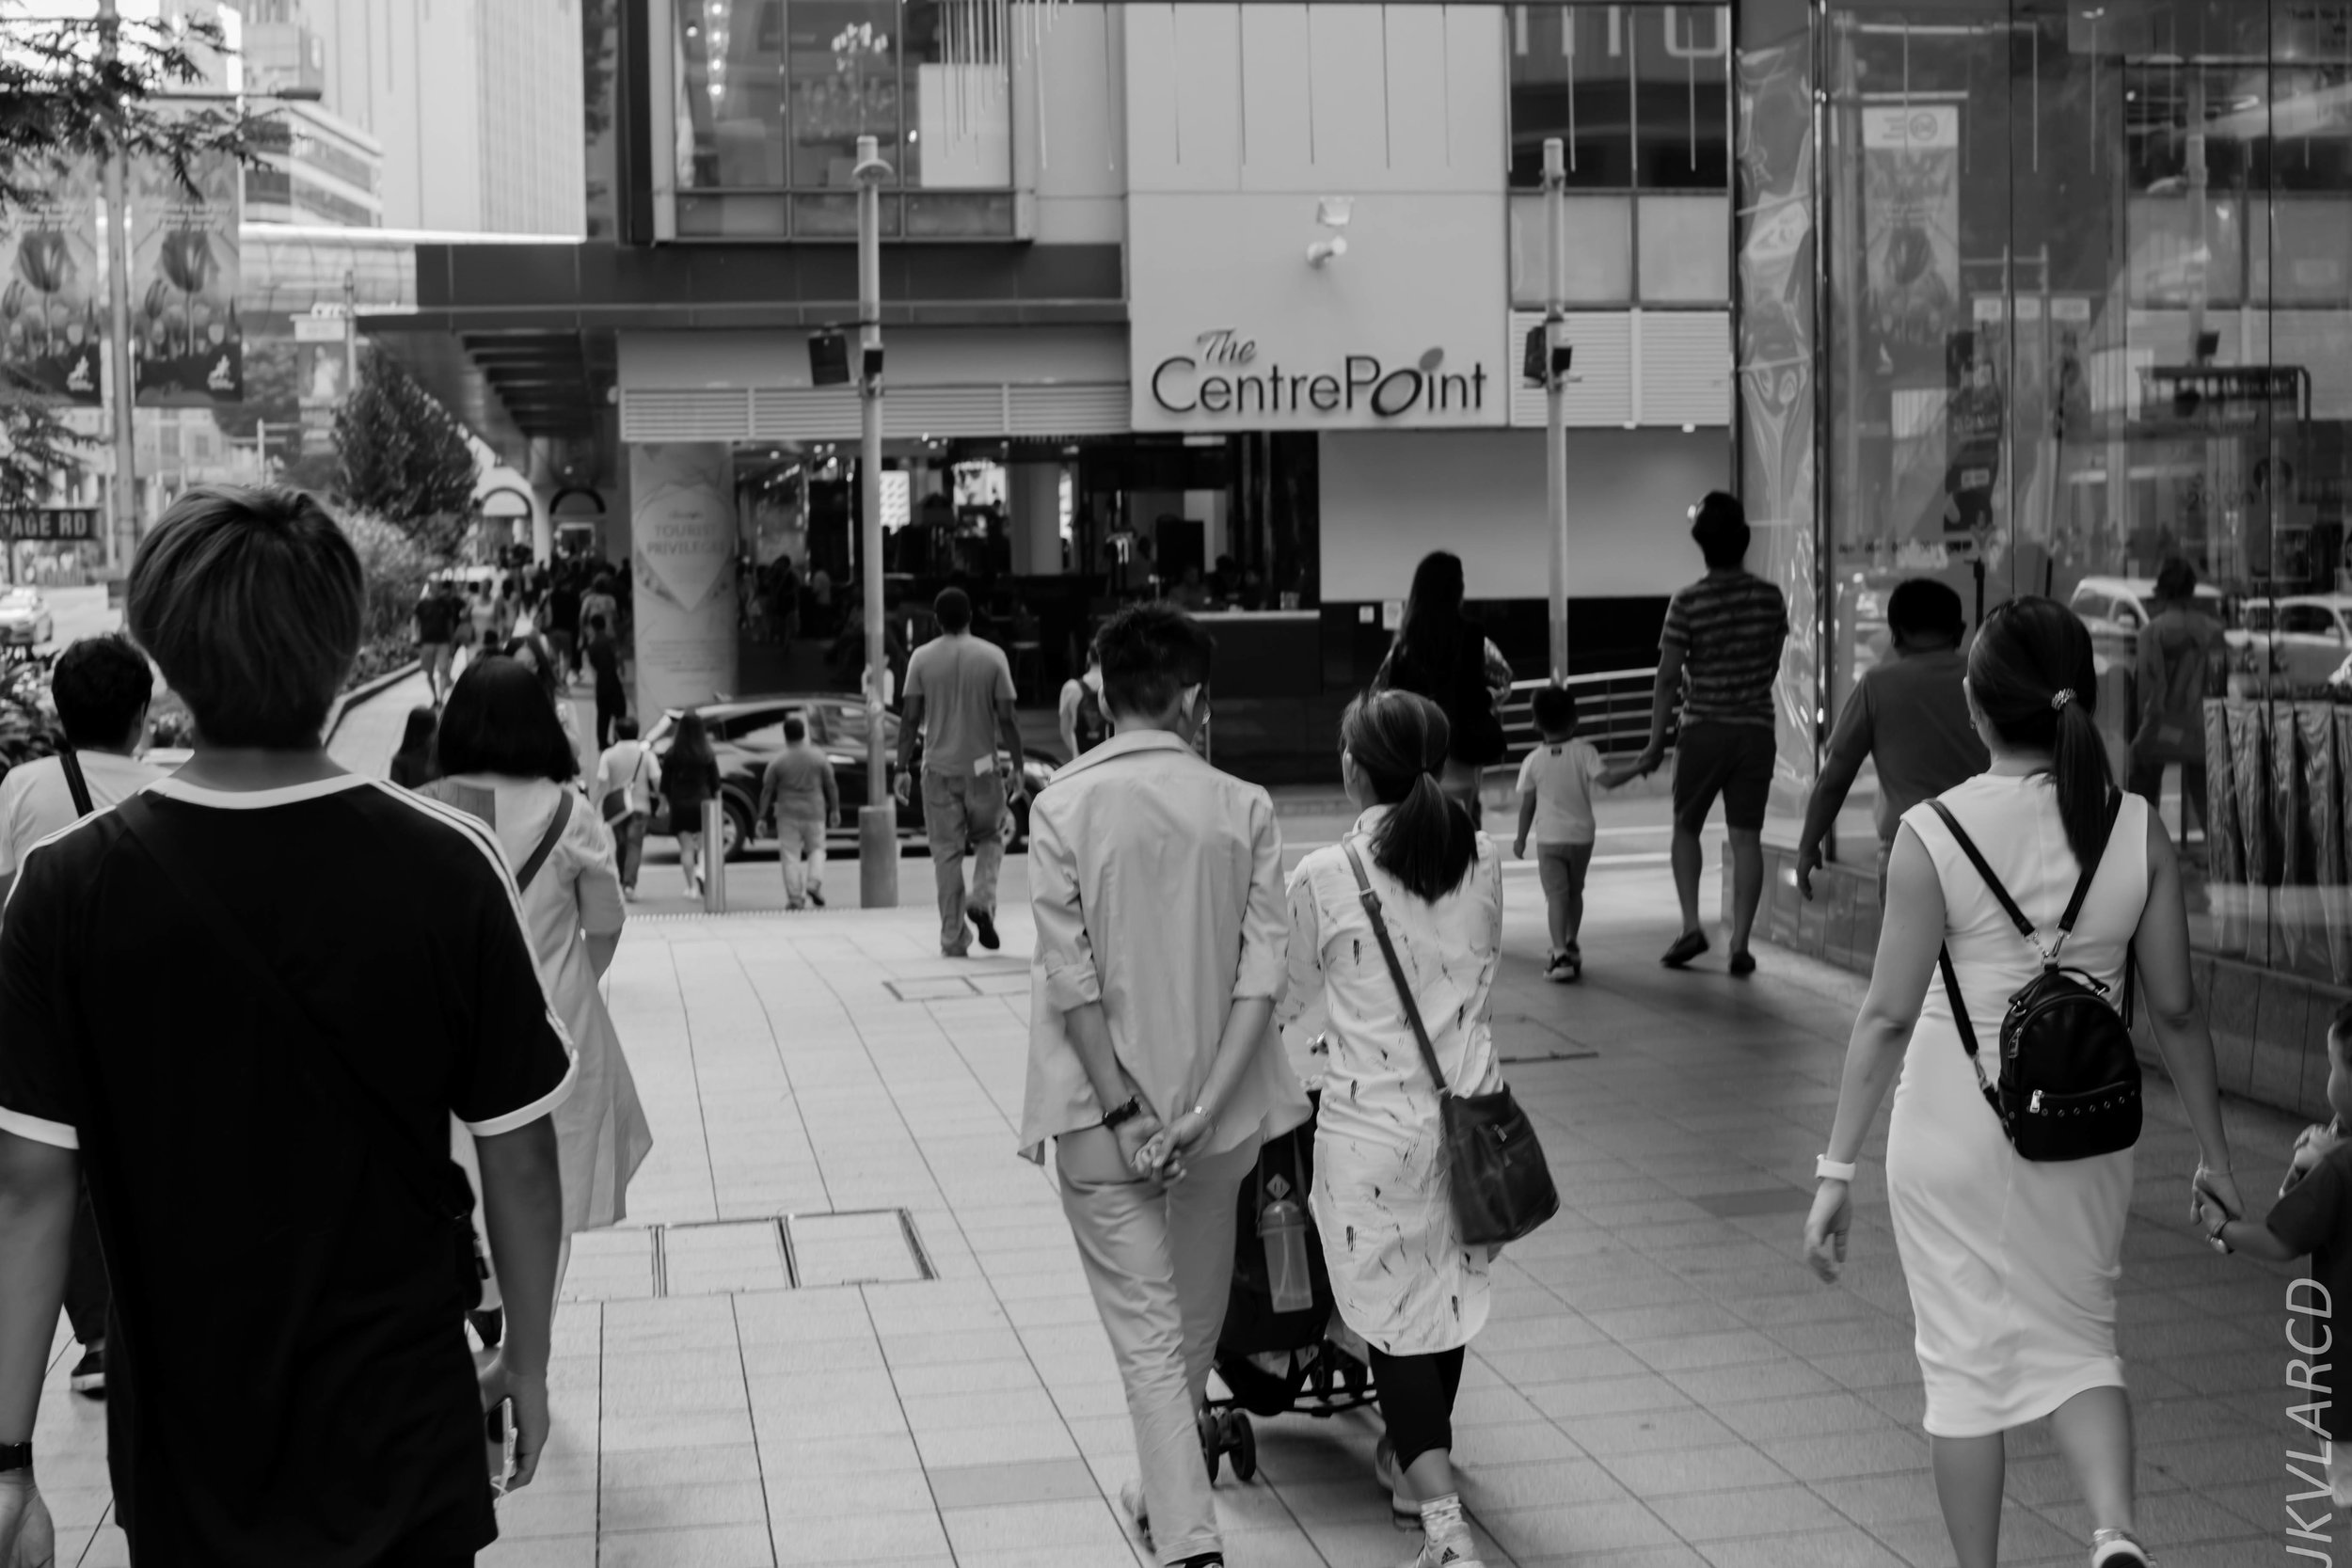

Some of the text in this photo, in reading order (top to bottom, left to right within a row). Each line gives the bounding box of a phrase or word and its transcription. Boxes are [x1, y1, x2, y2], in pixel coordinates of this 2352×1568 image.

[1197, 328, 1256, 364] The
[1152, 347, 1487, 418] CentrePoint
[58, 511, 87, 537] RD
